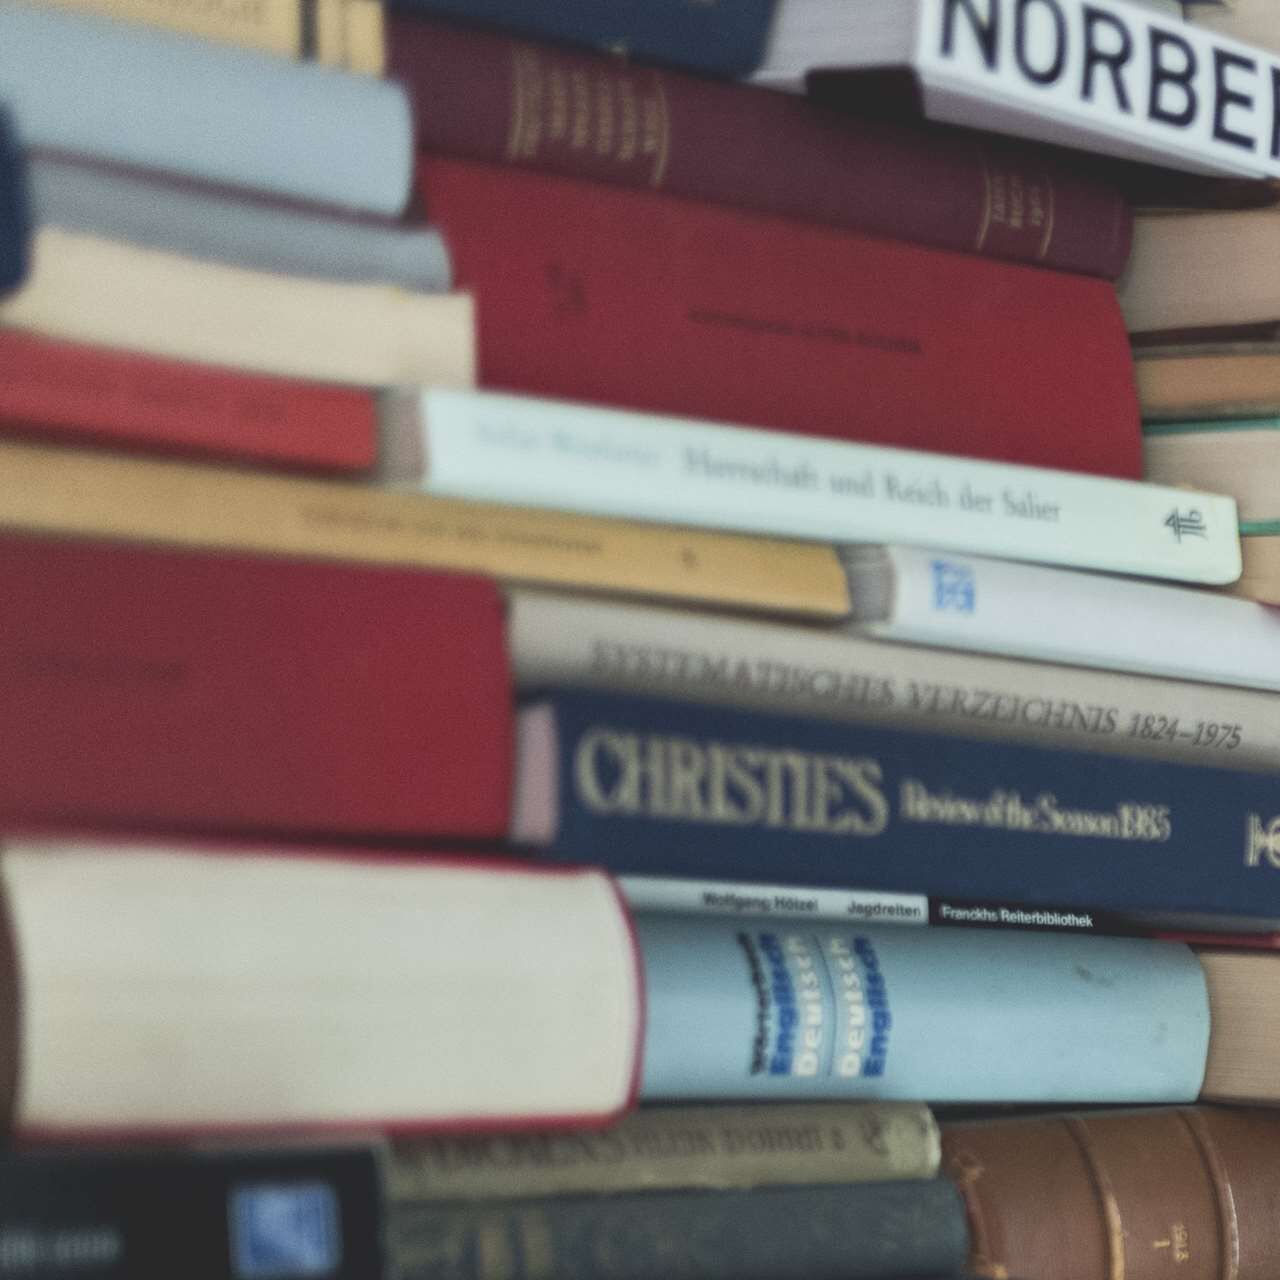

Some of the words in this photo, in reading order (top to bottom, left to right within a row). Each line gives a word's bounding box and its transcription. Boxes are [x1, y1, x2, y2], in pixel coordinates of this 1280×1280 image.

[830, 467, 875, 499] und
[884, 473, 949, 510] Reich
[960, 480, 994, 515] der
[1002, 486, 1062, 523] Salier
[906, 682, 1119, 734] VERZEICHNIS
[847, 899, 922, 922] Jagdreiten
[1001, 908, 1094, 930] Reiterbibliothek
